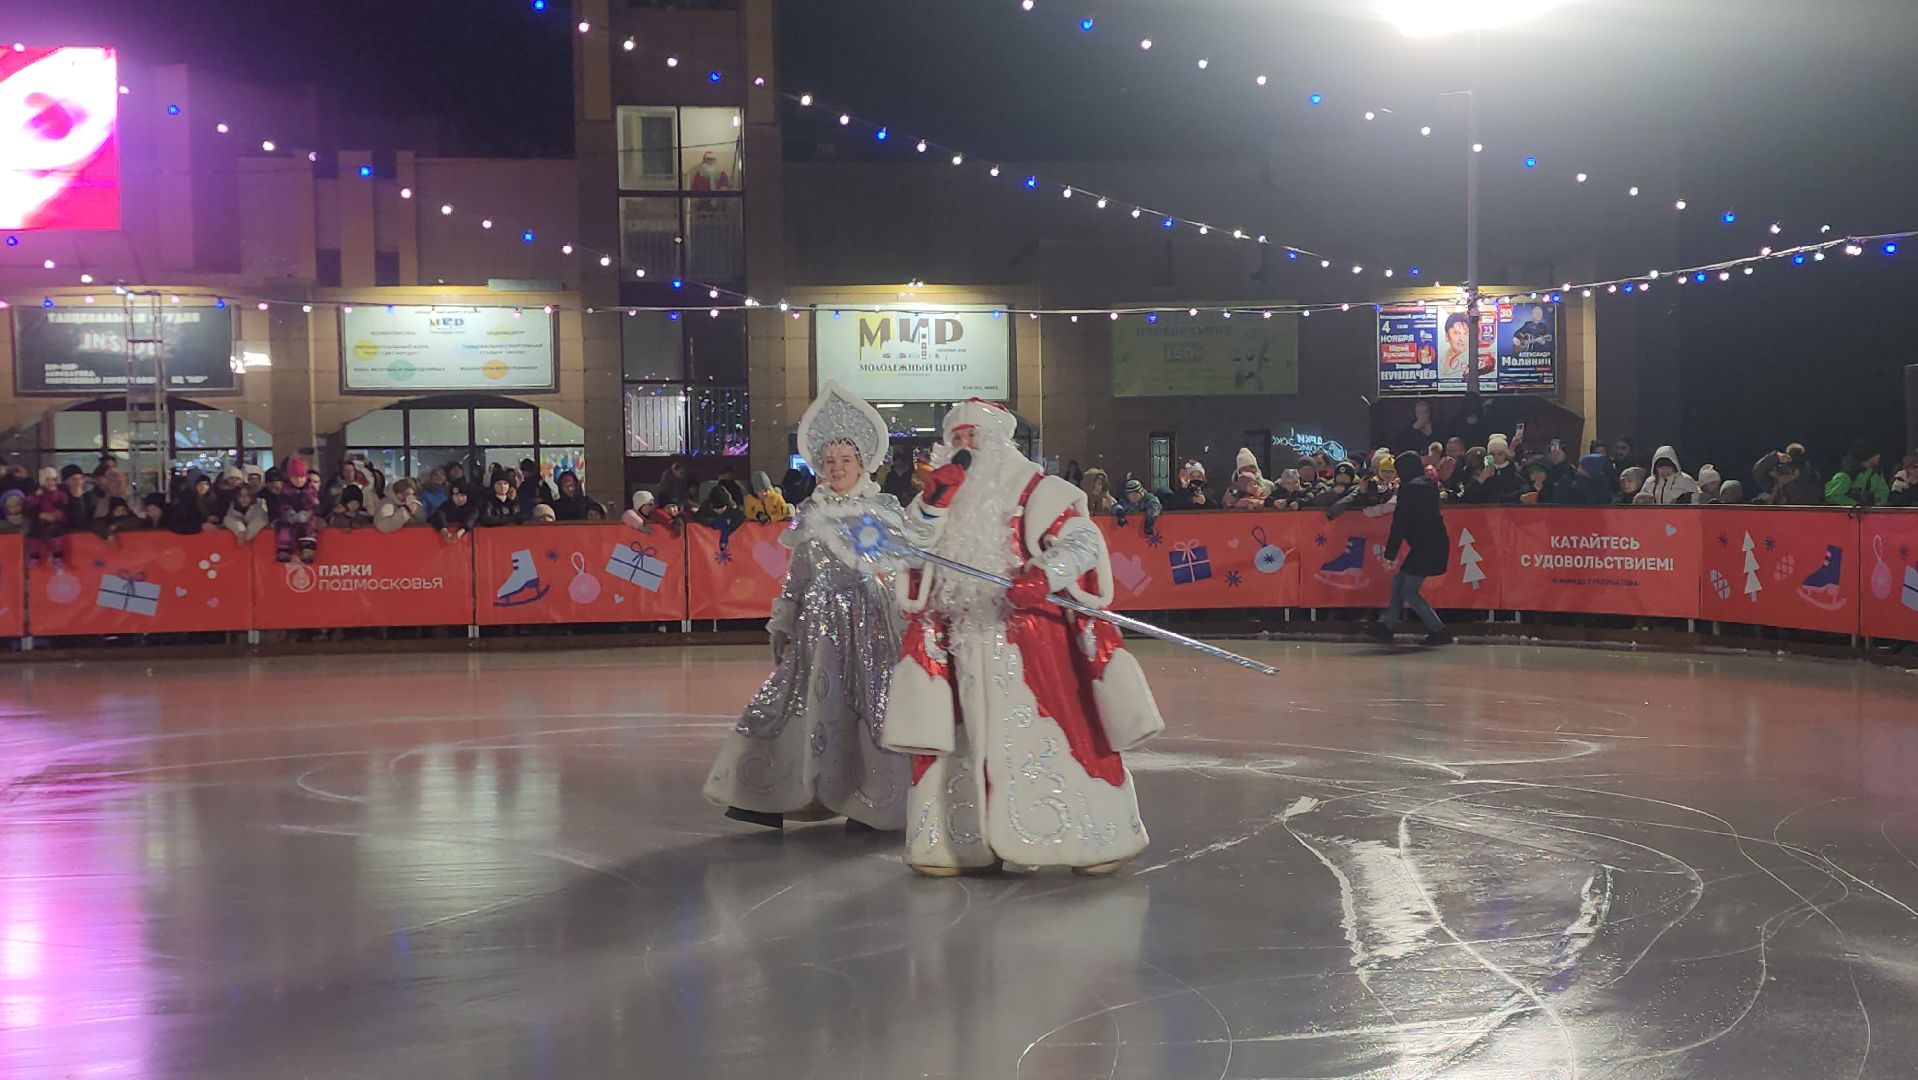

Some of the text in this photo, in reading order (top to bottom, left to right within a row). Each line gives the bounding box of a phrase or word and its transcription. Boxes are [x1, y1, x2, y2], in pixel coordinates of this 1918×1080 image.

[1382, 321, 1391, 333] 4
[859, 318, 964, 357] МИР
[1551, 532, 1640, 550] КАТАЙТЕСЬ
[319, 564, 372, 577] ПАРКИ
[1520, 555, 1674, 571] С УДОВОЛЬСТВИЕМ!
[319, 577, 443, 591] ПОДМОСКОВЬЯ
